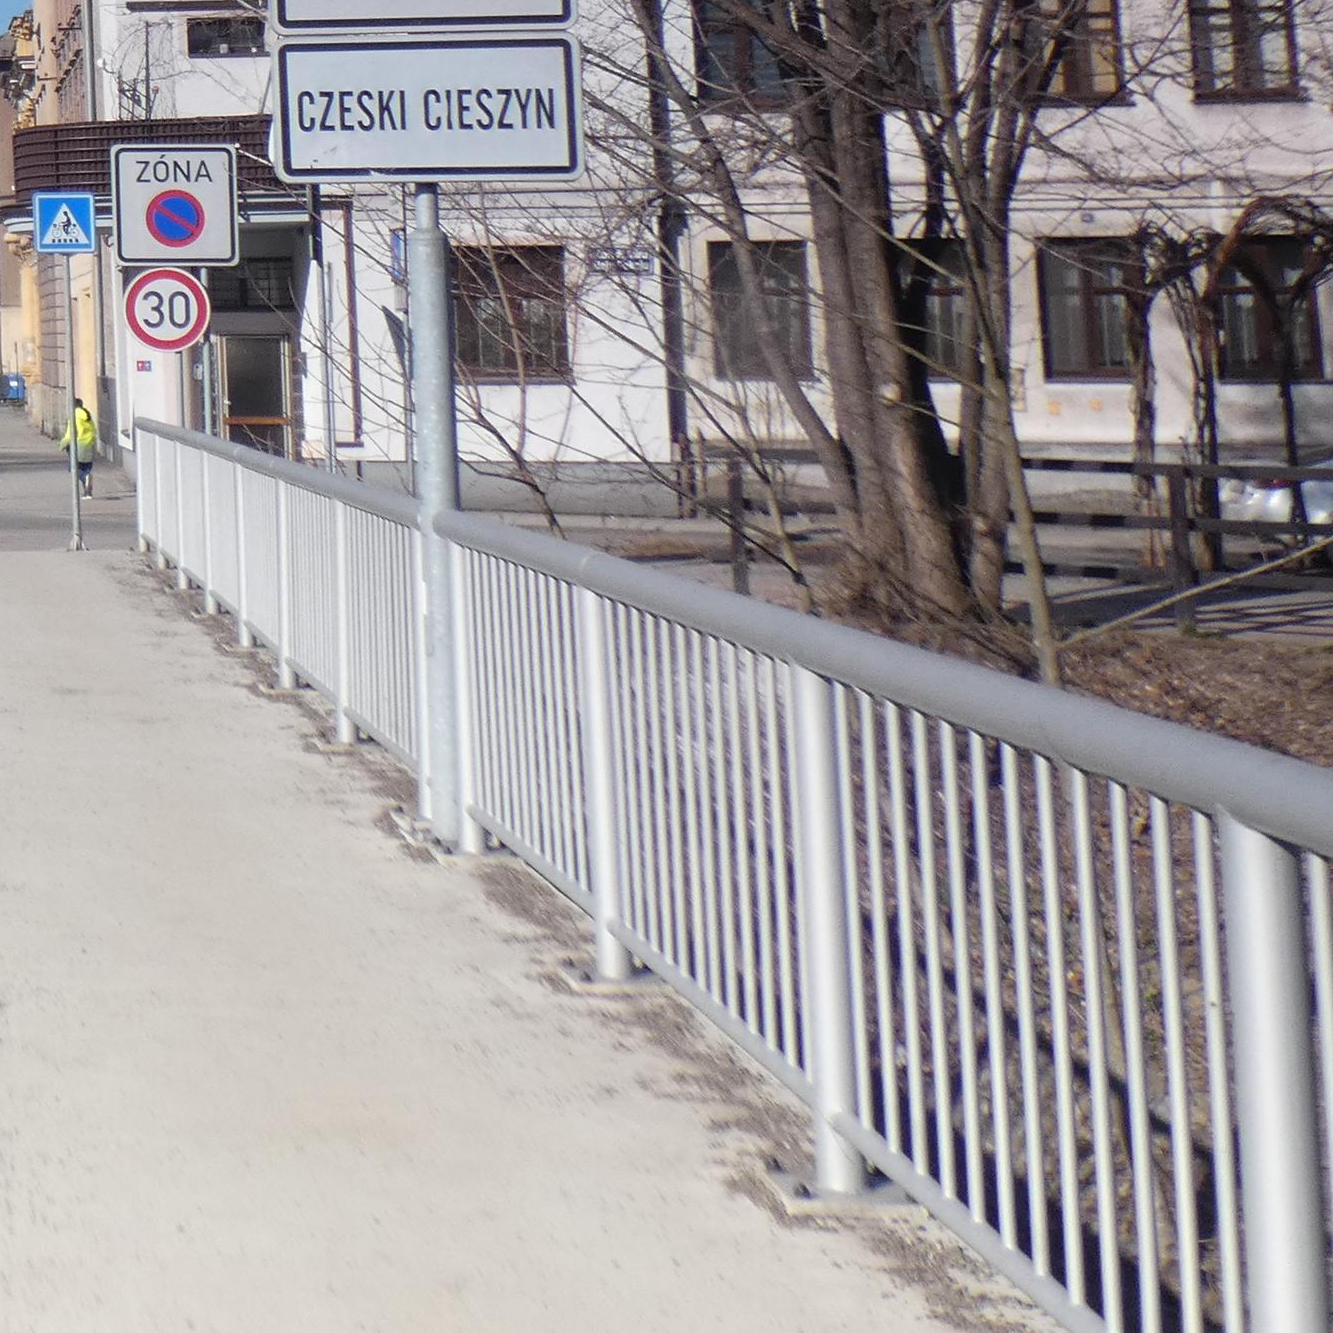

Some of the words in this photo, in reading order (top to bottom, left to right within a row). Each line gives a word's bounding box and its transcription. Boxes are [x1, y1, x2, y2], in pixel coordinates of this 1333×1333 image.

[297, 89, 407, 132] CZESKI
[423, 88, 555, 131] CIESZYN
[136, 154, 213, 183] ZÓNA
[142, 291, 191, 329] 30
